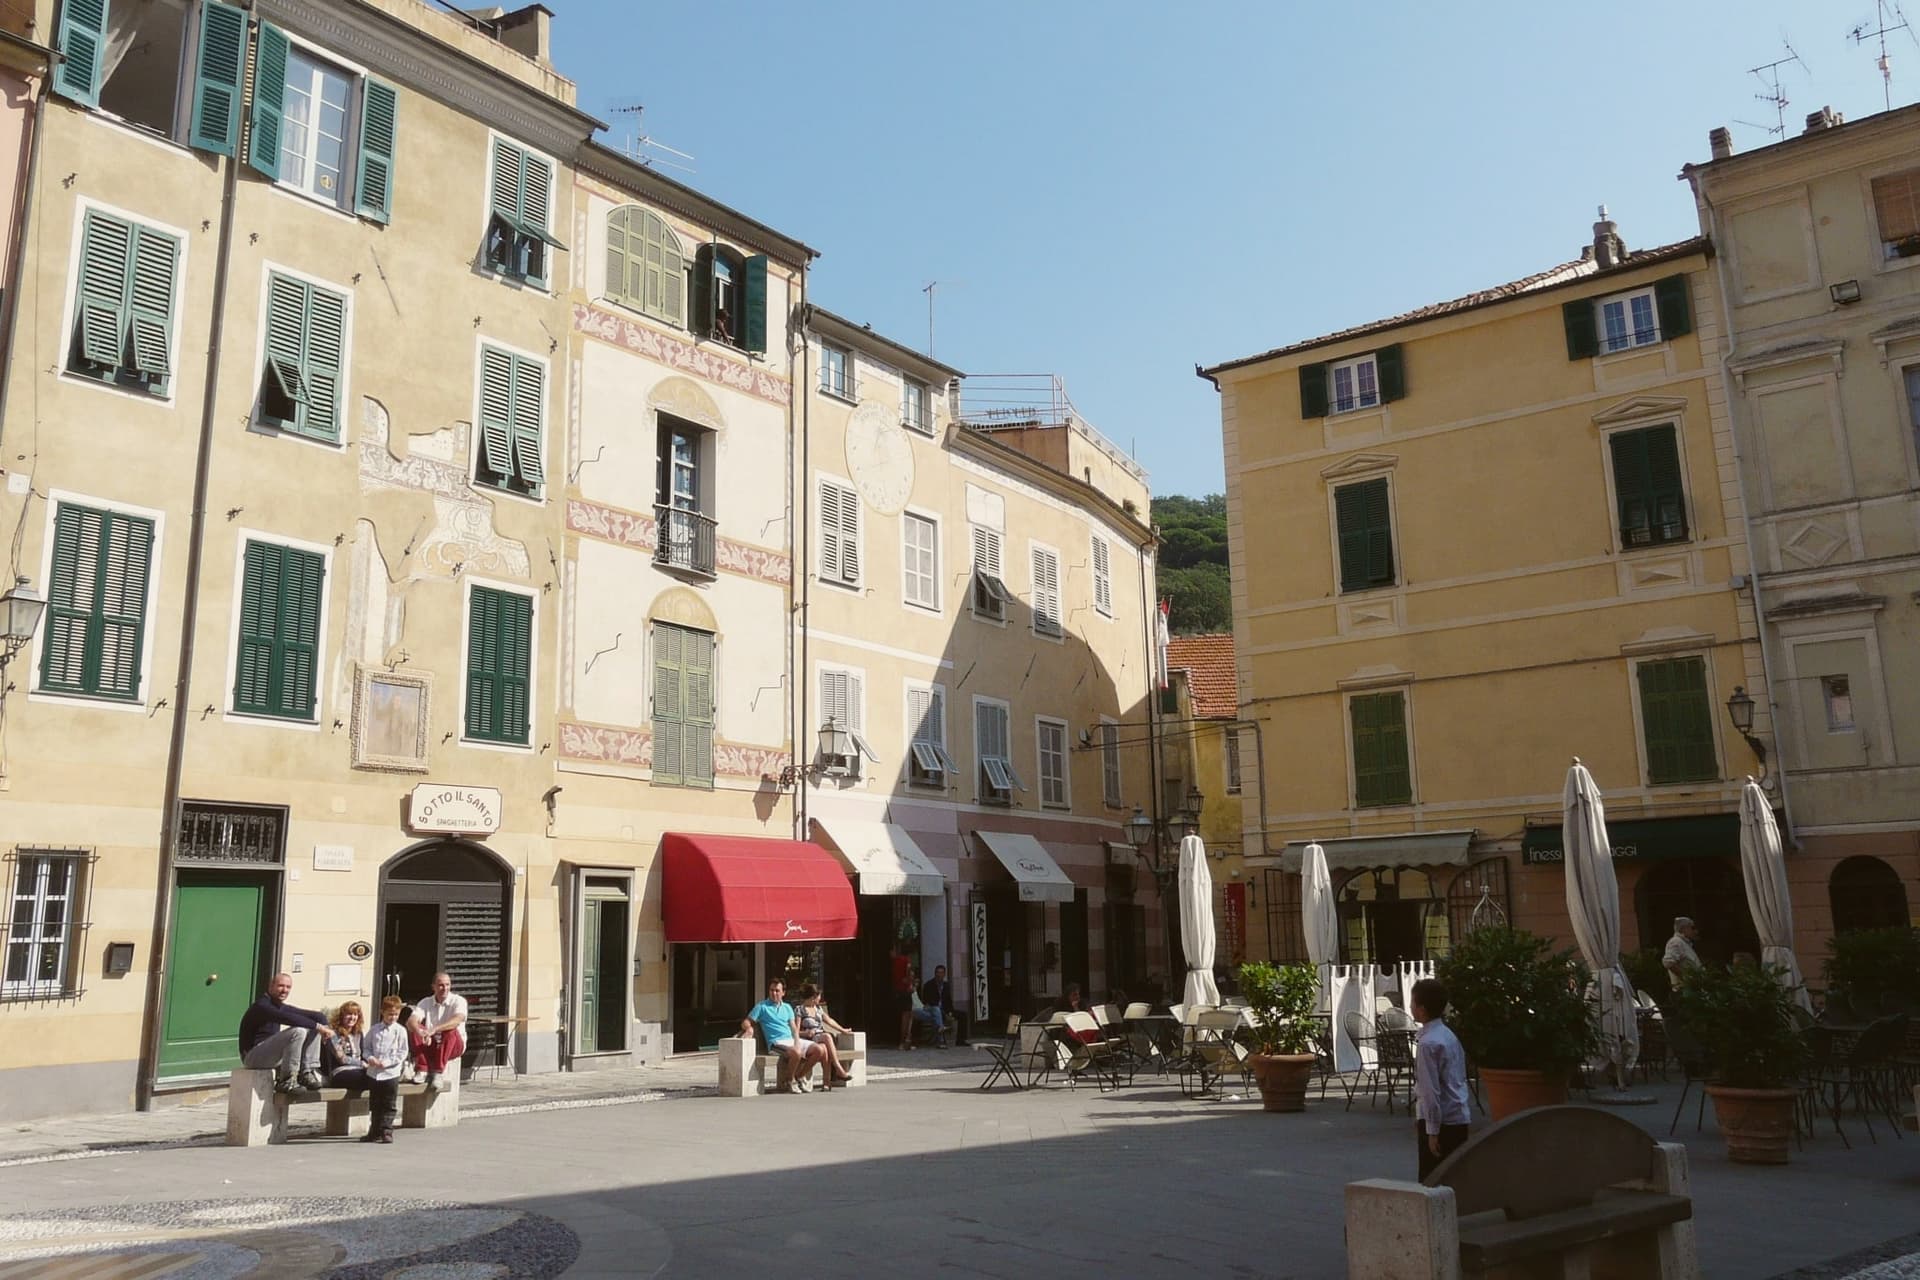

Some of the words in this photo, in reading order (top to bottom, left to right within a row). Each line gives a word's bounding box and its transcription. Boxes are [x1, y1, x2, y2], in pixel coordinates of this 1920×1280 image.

[418, 791, 453, 824] SOTTO
[455, 791, 464, 802] IL
[467, 793, 493, 827] SANTO
